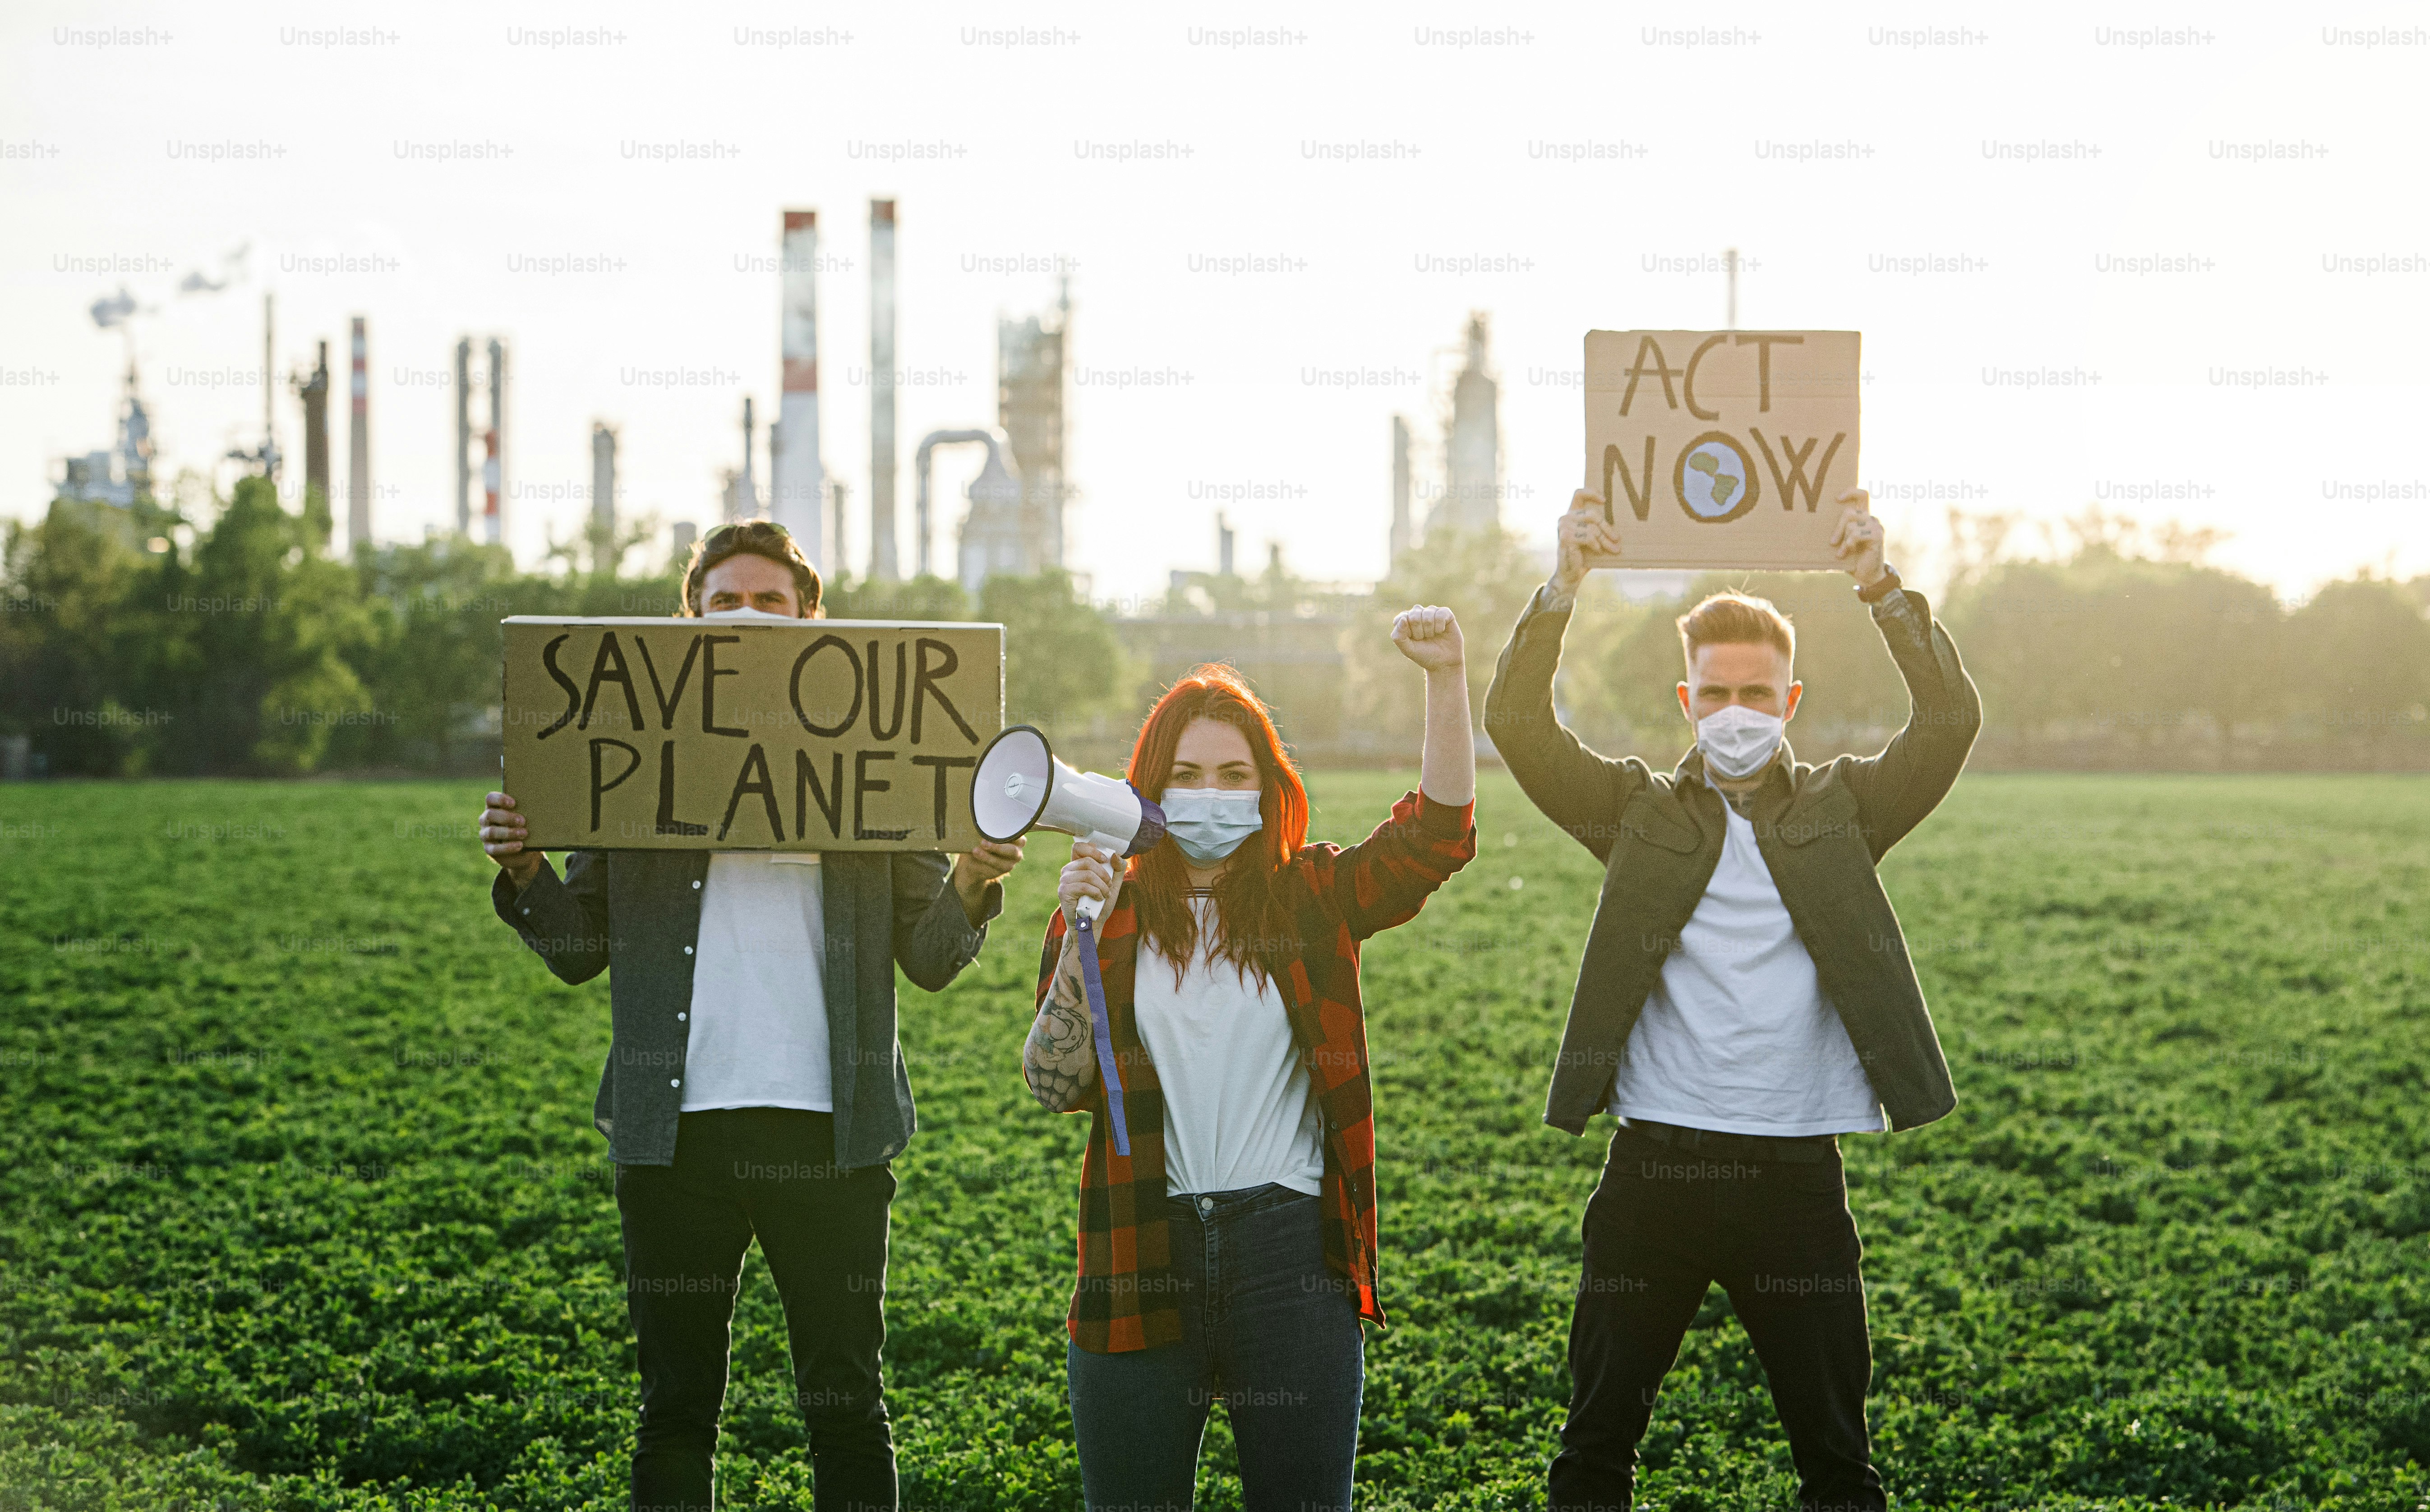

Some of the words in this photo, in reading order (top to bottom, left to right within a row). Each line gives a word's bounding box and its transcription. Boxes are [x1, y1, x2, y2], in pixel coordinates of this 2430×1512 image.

[1618, 334, 1804, 421] ACT
[1603, 427, 1847, 526] NOW
[537, 632, 749, 740] SAVE
[788, 634, 980, 745] OUR
[589, 738, 977, 842] PLANET
